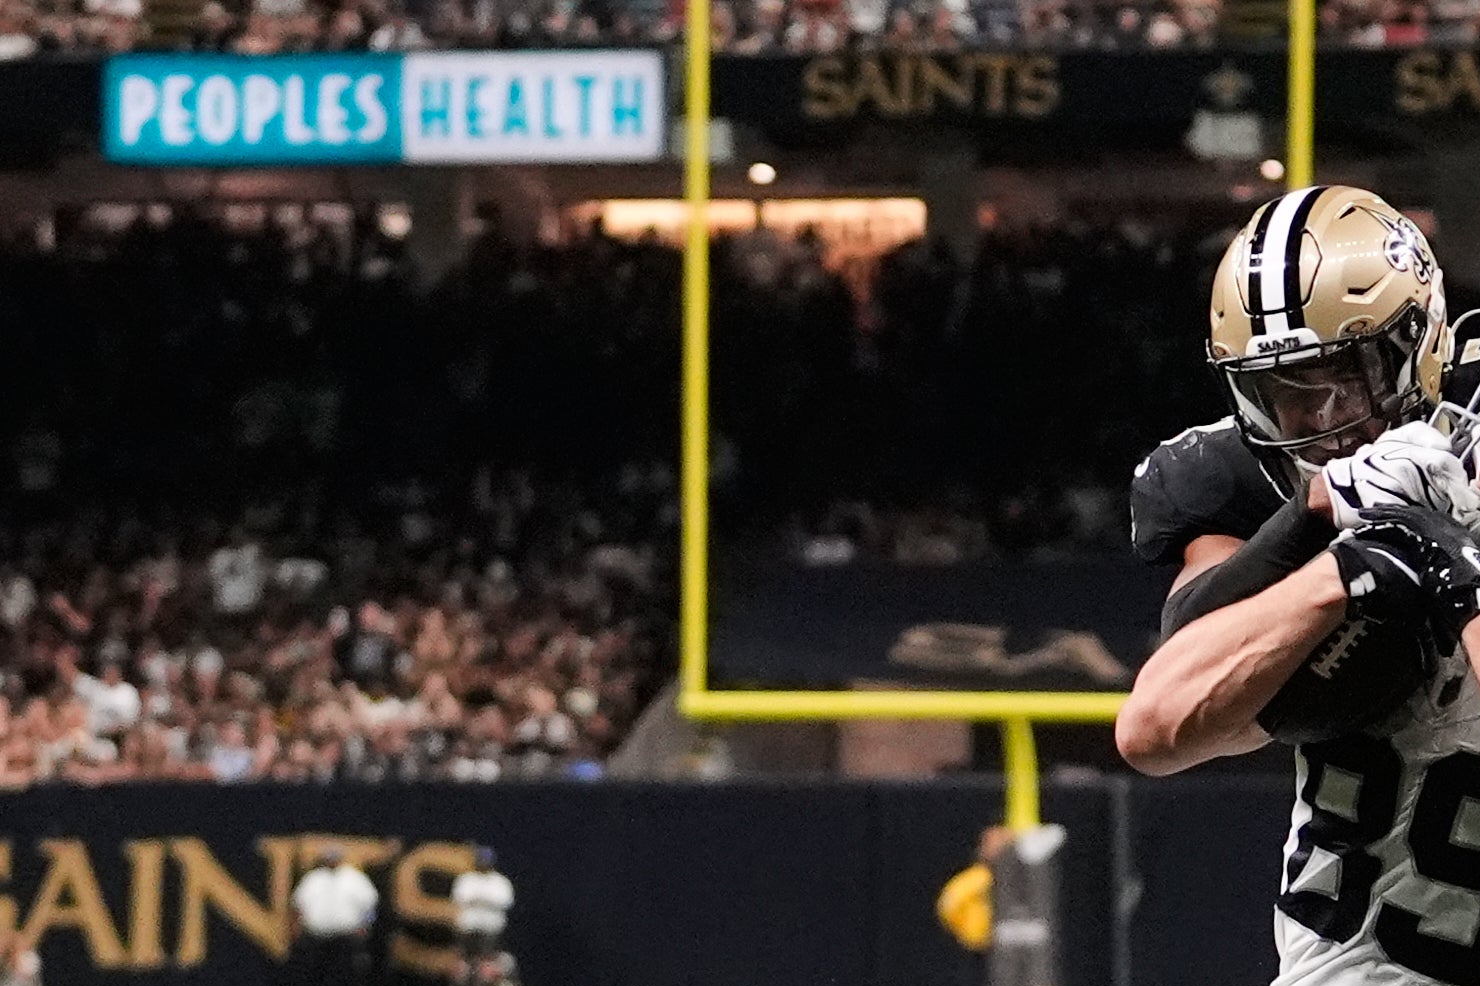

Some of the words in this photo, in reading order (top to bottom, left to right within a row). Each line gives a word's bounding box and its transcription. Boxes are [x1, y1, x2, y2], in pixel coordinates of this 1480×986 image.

[118, 73, 388, 146] PEOPLES
[418, 75, 646, 140] HEALTH
[803, 50, 1062, 118] SAINTS
[1257, 336, 1301, 353] SAINTS
